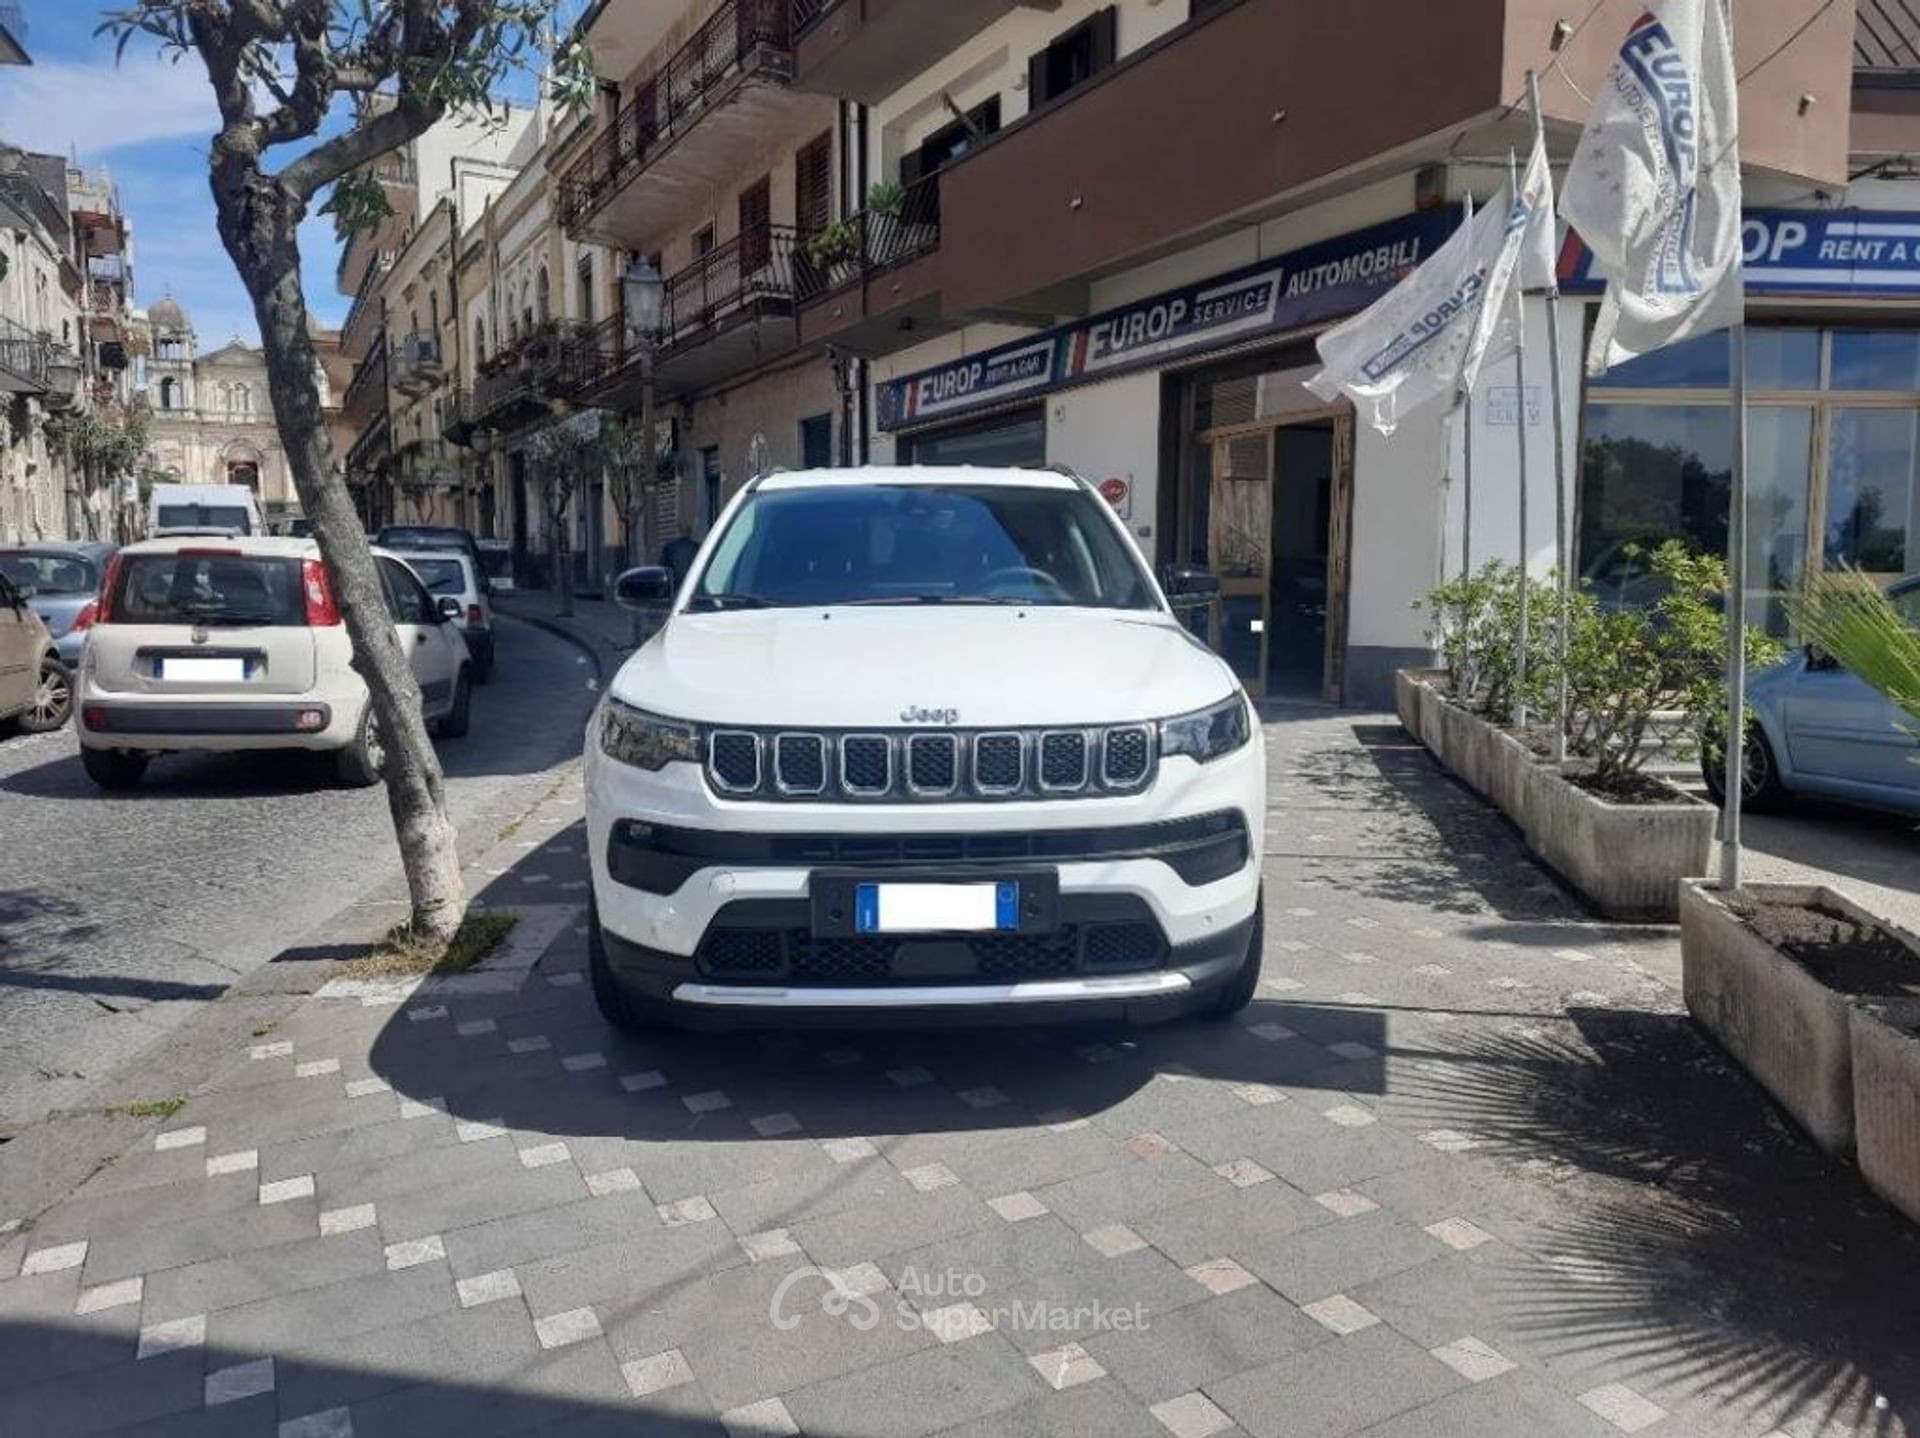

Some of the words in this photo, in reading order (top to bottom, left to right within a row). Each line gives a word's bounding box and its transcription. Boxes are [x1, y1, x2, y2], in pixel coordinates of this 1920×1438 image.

[1620, 21, 1697, 172] EUROP
[1818, 240, 1886, 261] RENT
[1889, 241, 1907, 261] A
[1087, 299, 1187, 360] EUROP
[1192, 286, 1268, 324] SERVICE
[1284, 237, 1421, 299] AUTOMOBILI
[917, 362, 983, 406] EUROP
[1019, 357, 1041, 374] CAR
[900, 705, 960, 725] Jeep
